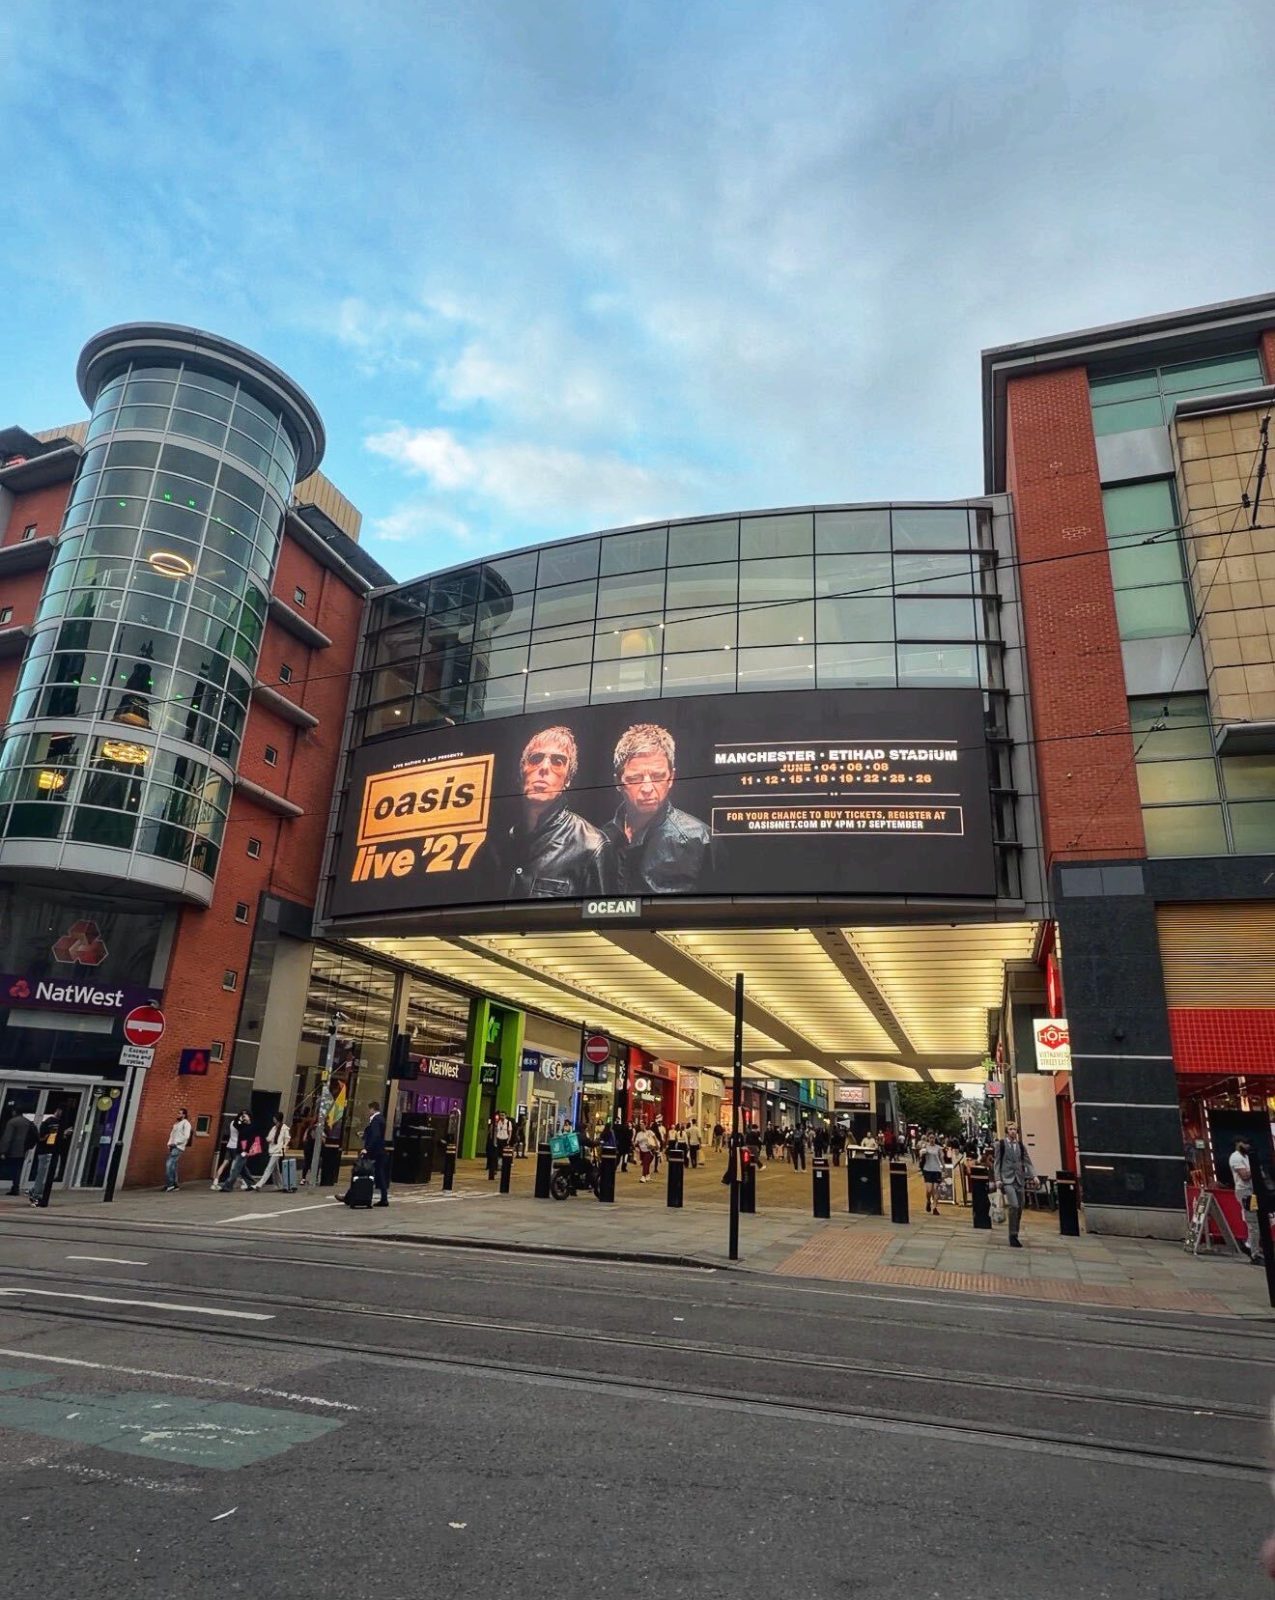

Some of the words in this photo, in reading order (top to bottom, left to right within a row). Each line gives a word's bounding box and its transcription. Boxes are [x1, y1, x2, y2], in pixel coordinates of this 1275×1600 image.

[715, 751, 816, 764] MANCHESTER
[829, 750, 885, 760] ETIHAD
[889, 750, 958, 761] STADIUM
[780, 763, 812, 772] JUNE
[821, 763, 837, 771] 04
[872, 762, 889, 771] 08
[740, 776, 753, 785] 11
[764, 776, 779, 784] 12
[789, 775, 803, 784] 15
[839, 774, 854, 783] 19
[863, 774, 880, 783] 22
[889, 774, 905, 783] 25
[915, 774, 932, 783] 26
[373, 776, 475, 820] oasis
[726, 812, 743, 821] FOR
[745, 812, 769, 820] YOUR
[771, 811, 807, 820] CHANCE
[809, 811, 821, 819] TO
[824, 811, 842, 819] BUY
[887, 811, 932, 820] REGISTER
[933, 811, 946, 820] AT
[820, 820, 832, 828] BY
[834, 820, 855, 829] 4PM
[868, 820, 924, 829] SEPTEMBER
[351, 844, 415, 882] live
[587, 900, 637, 914] OCEAN
[35, 982, 124, 1007] NatWest
[428, 1059, 459, 1078] NatWest
